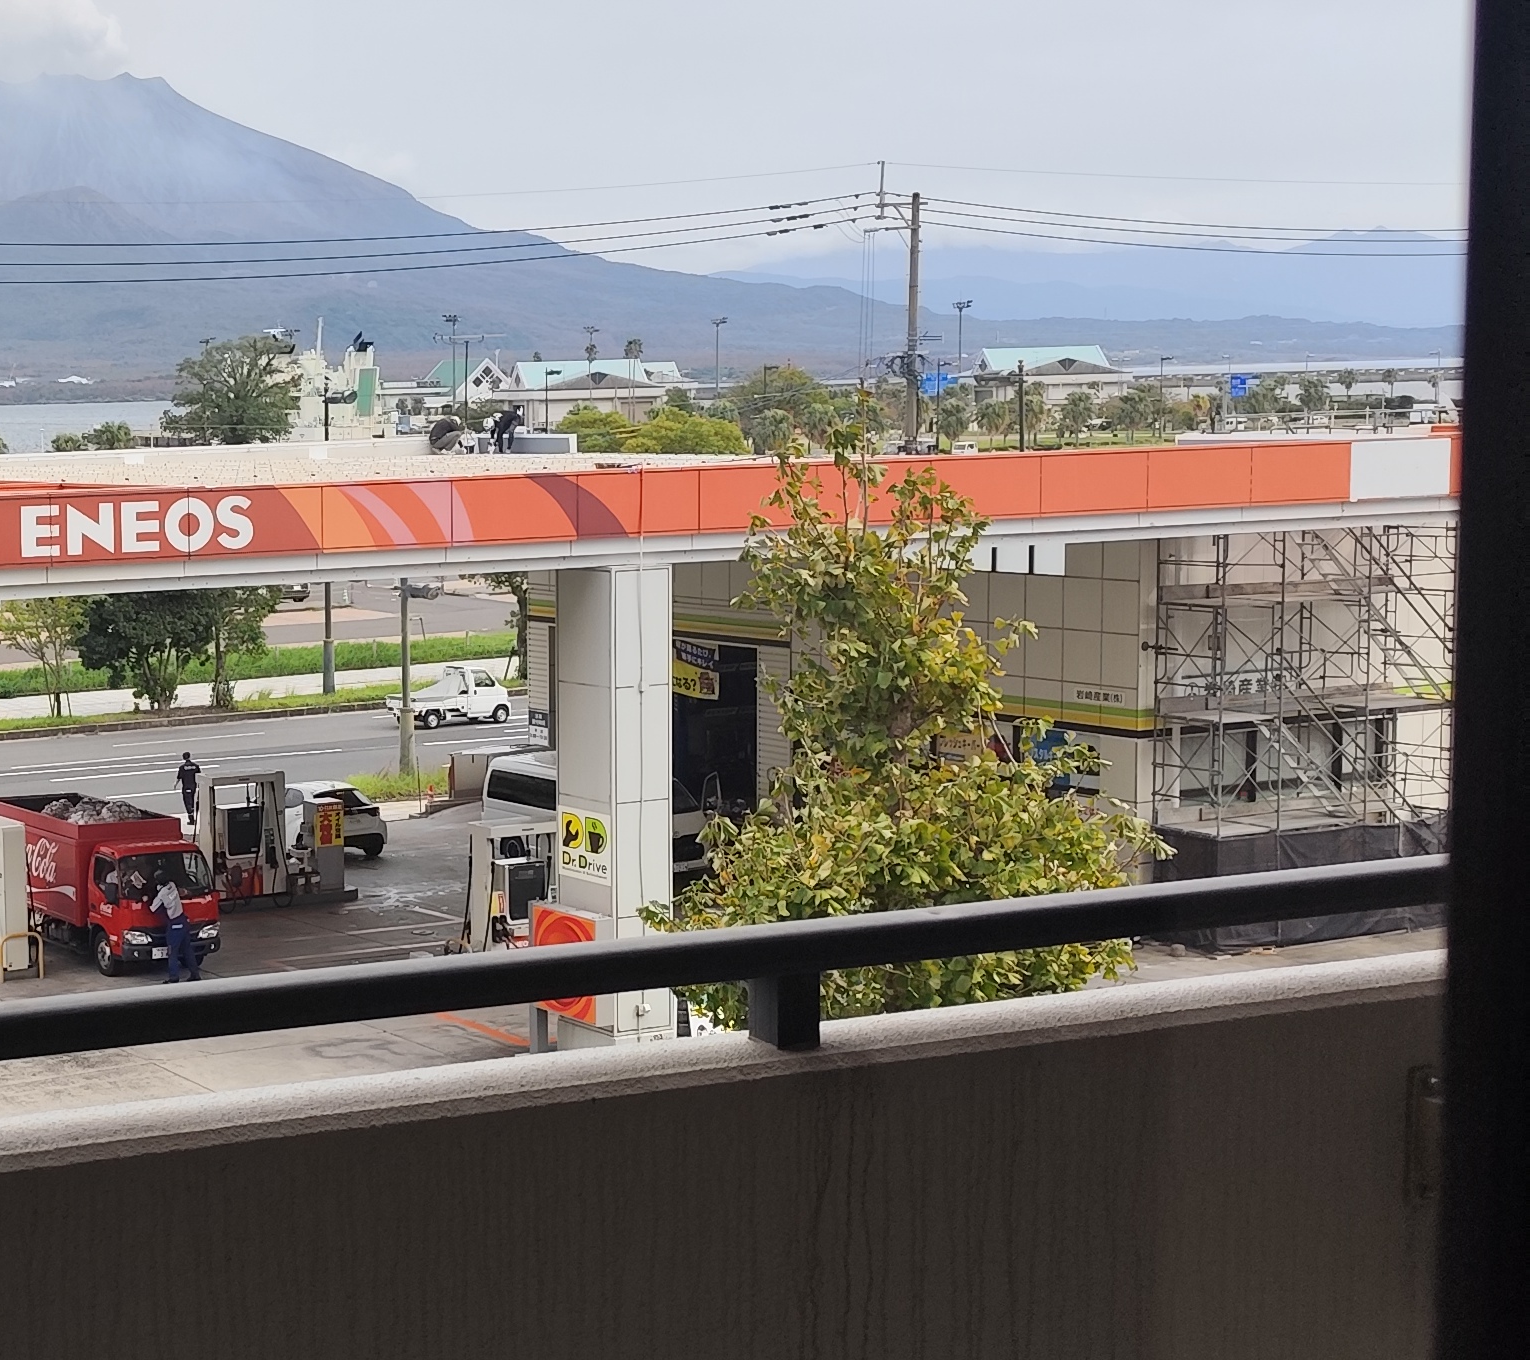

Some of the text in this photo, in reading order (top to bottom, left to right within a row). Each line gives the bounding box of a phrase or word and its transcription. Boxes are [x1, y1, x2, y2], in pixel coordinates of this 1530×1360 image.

[20, 495, 254, 558] ENEOS
[562, 850, 577, 868] Dr.
[578, 854, 608, 875] Drive
